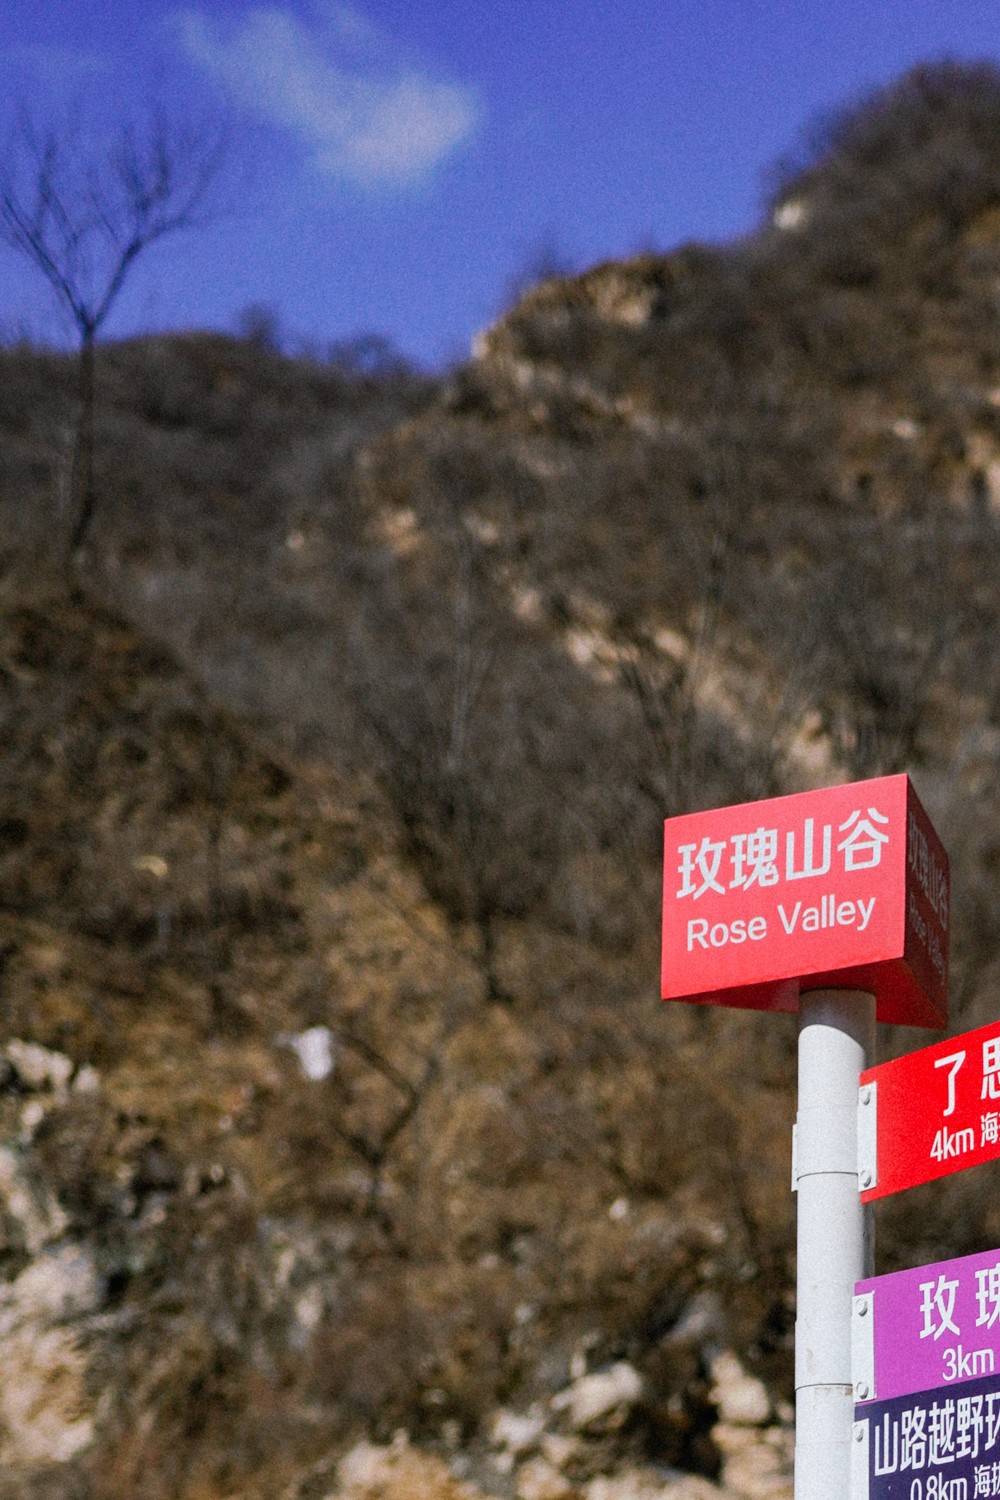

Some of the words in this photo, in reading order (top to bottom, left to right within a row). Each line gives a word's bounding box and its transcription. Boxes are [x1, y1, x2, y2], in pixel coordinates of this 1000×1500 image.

[676, 807, 889, 900] 玫瑰山谷
[687, 917, 767, 952] Rose
[778, 894, 876, 935] Valley
[930, 1127, 975, 1162] 4km
[942, 1344, 995, 1381] 3km
